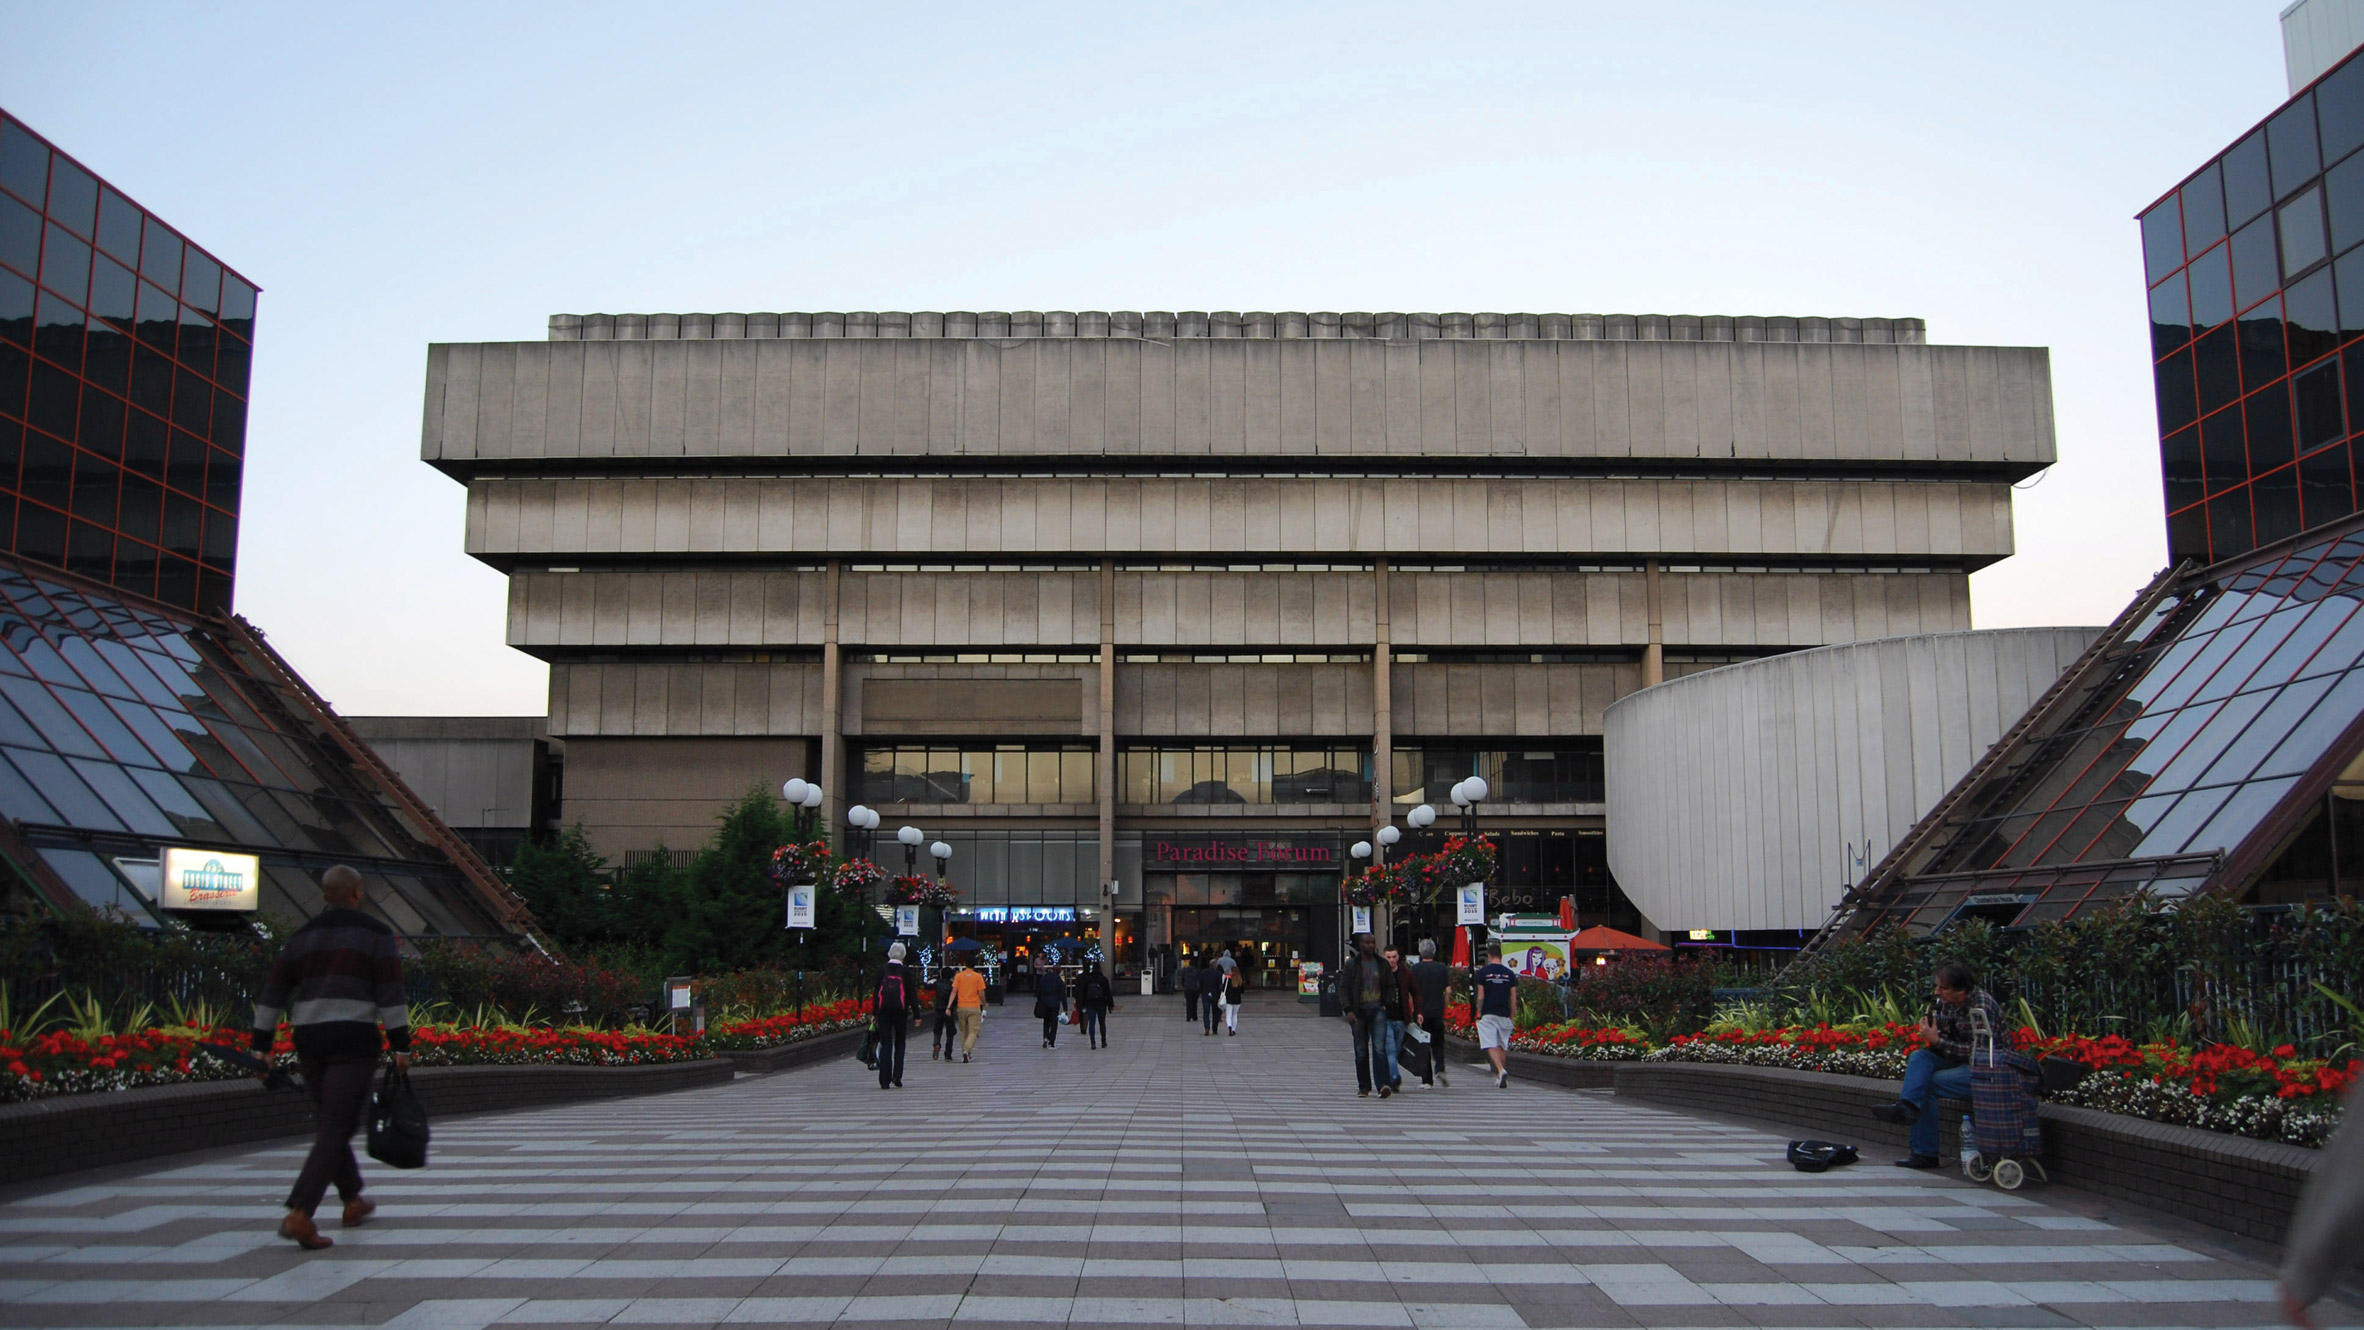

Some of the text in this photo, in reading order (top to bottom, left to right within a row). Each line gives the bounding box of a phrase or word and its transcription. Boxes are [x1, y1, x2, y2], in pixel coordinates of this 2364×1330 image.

[1156, 840, 1331, 862] Paradise Forum
[189, 887, 238, 902] Brasserie
